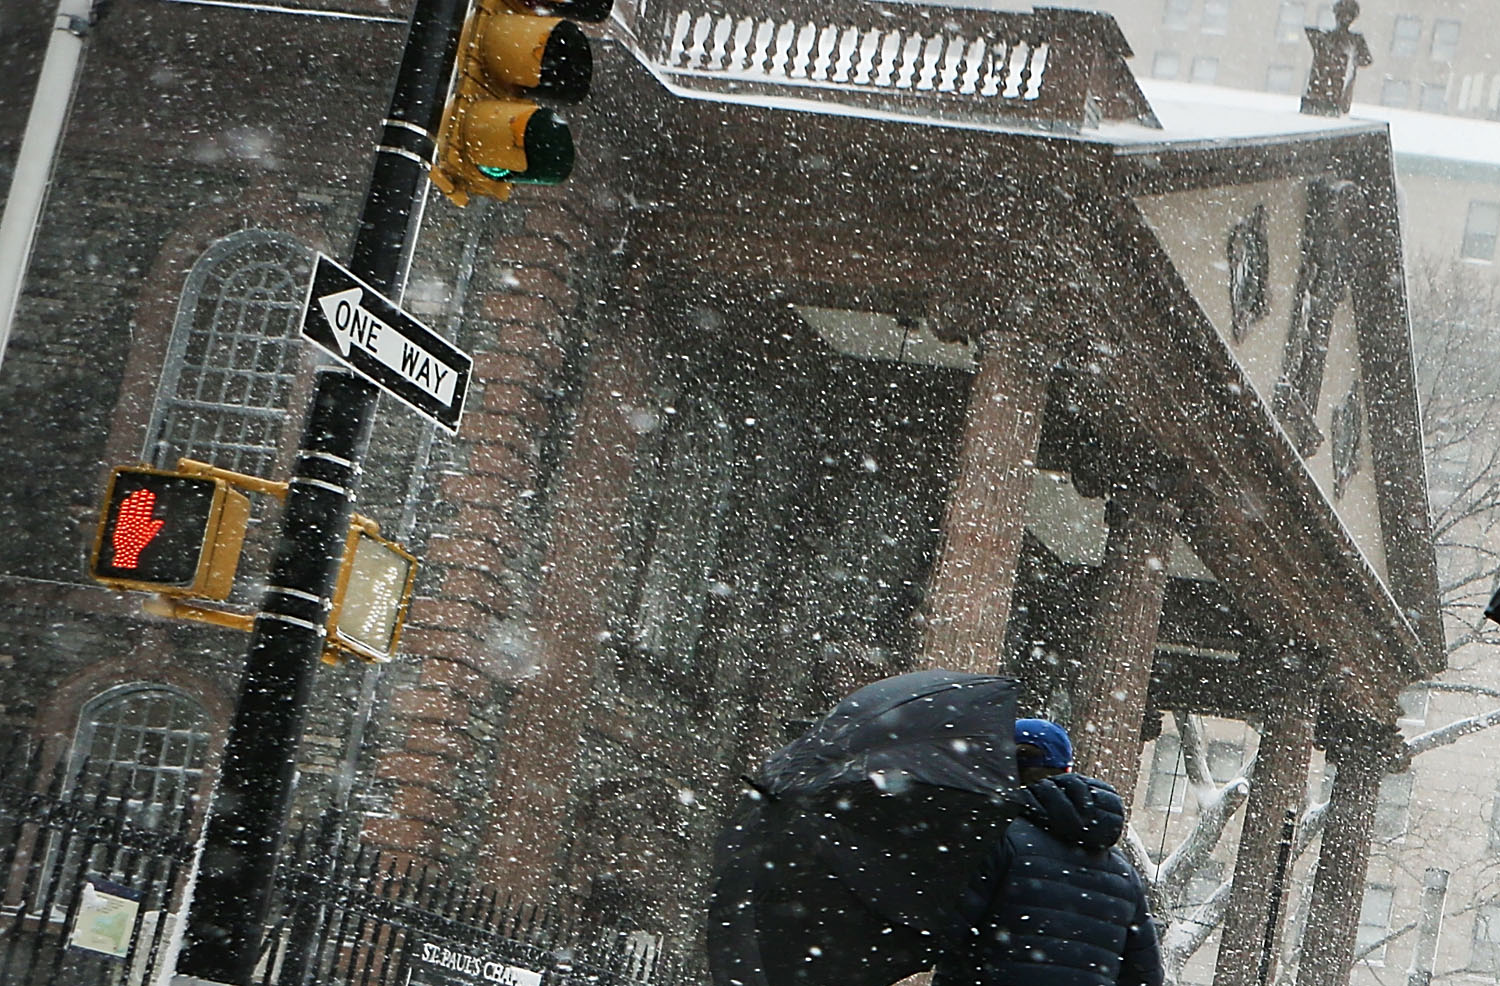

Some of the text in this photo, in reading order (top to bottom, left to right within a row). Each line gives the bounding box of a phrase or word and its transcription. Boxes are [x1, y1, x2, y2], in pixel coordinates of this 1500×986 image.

[335, 300, 448, 394] ONE WAY
[440, 947, 482, 976] PAUL'S
